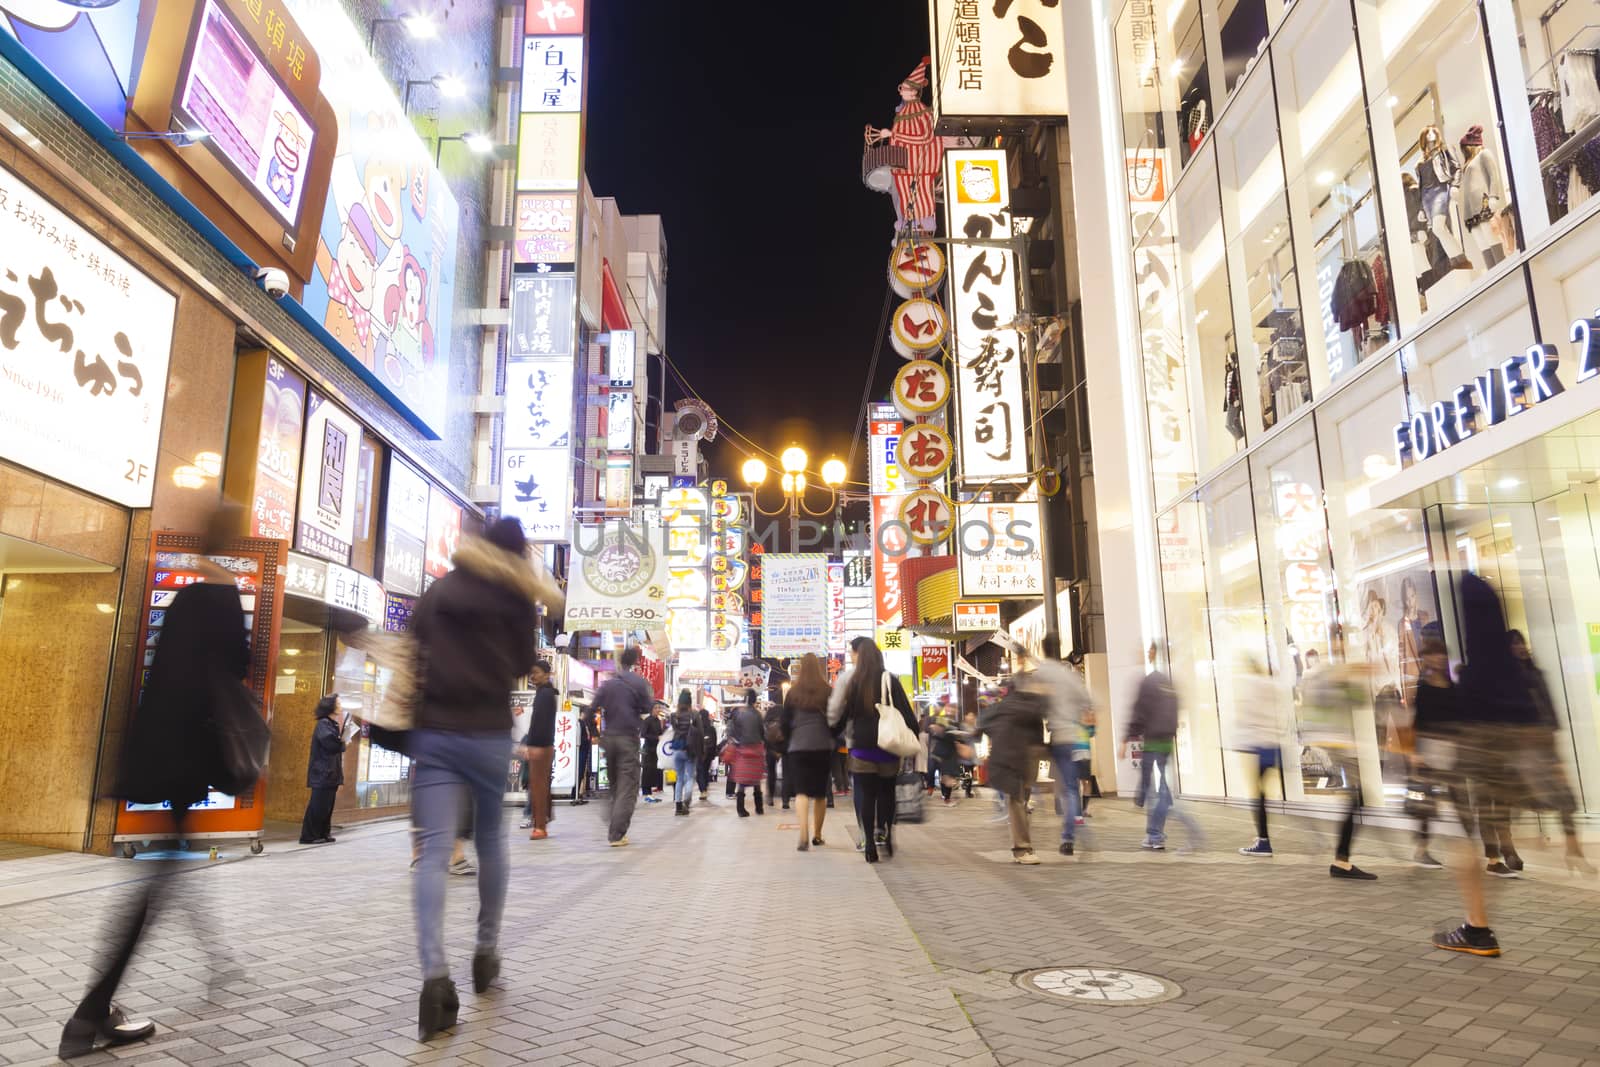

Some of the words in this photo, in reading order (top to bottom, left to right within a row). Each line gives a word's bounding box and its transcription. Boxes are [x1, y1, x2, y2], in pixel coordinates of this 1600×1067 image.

[527, 41, 541, 51] 4F
[956, 0, 982, 90] 道頓堀店
[542, 44, 577, 107] 白木屋
[537, 263, 551, 273] 3F
[516, 280, 535, 292] 2F
[268, 359, 286, 381] 3F
[1393, 343, 1560, 471] FOREVER
[1569, 309, 1600, 384] 2
[527, 369, 550, 440] ぼてぢゅう
[877, 423, 897, 434] 3F
[555, 438, 568, 446] 2F
[507, 455, 526, 469] 6F
[124, 458, 149, 485] 2F
[648, 586, 664, 599] 2F
[567, 607, 612, 618] CAFE
[885, 631, 902, 648] 薬
[923, 647, 947, 656] ツルハ
[557, 715, 572, 768] 串かつ
